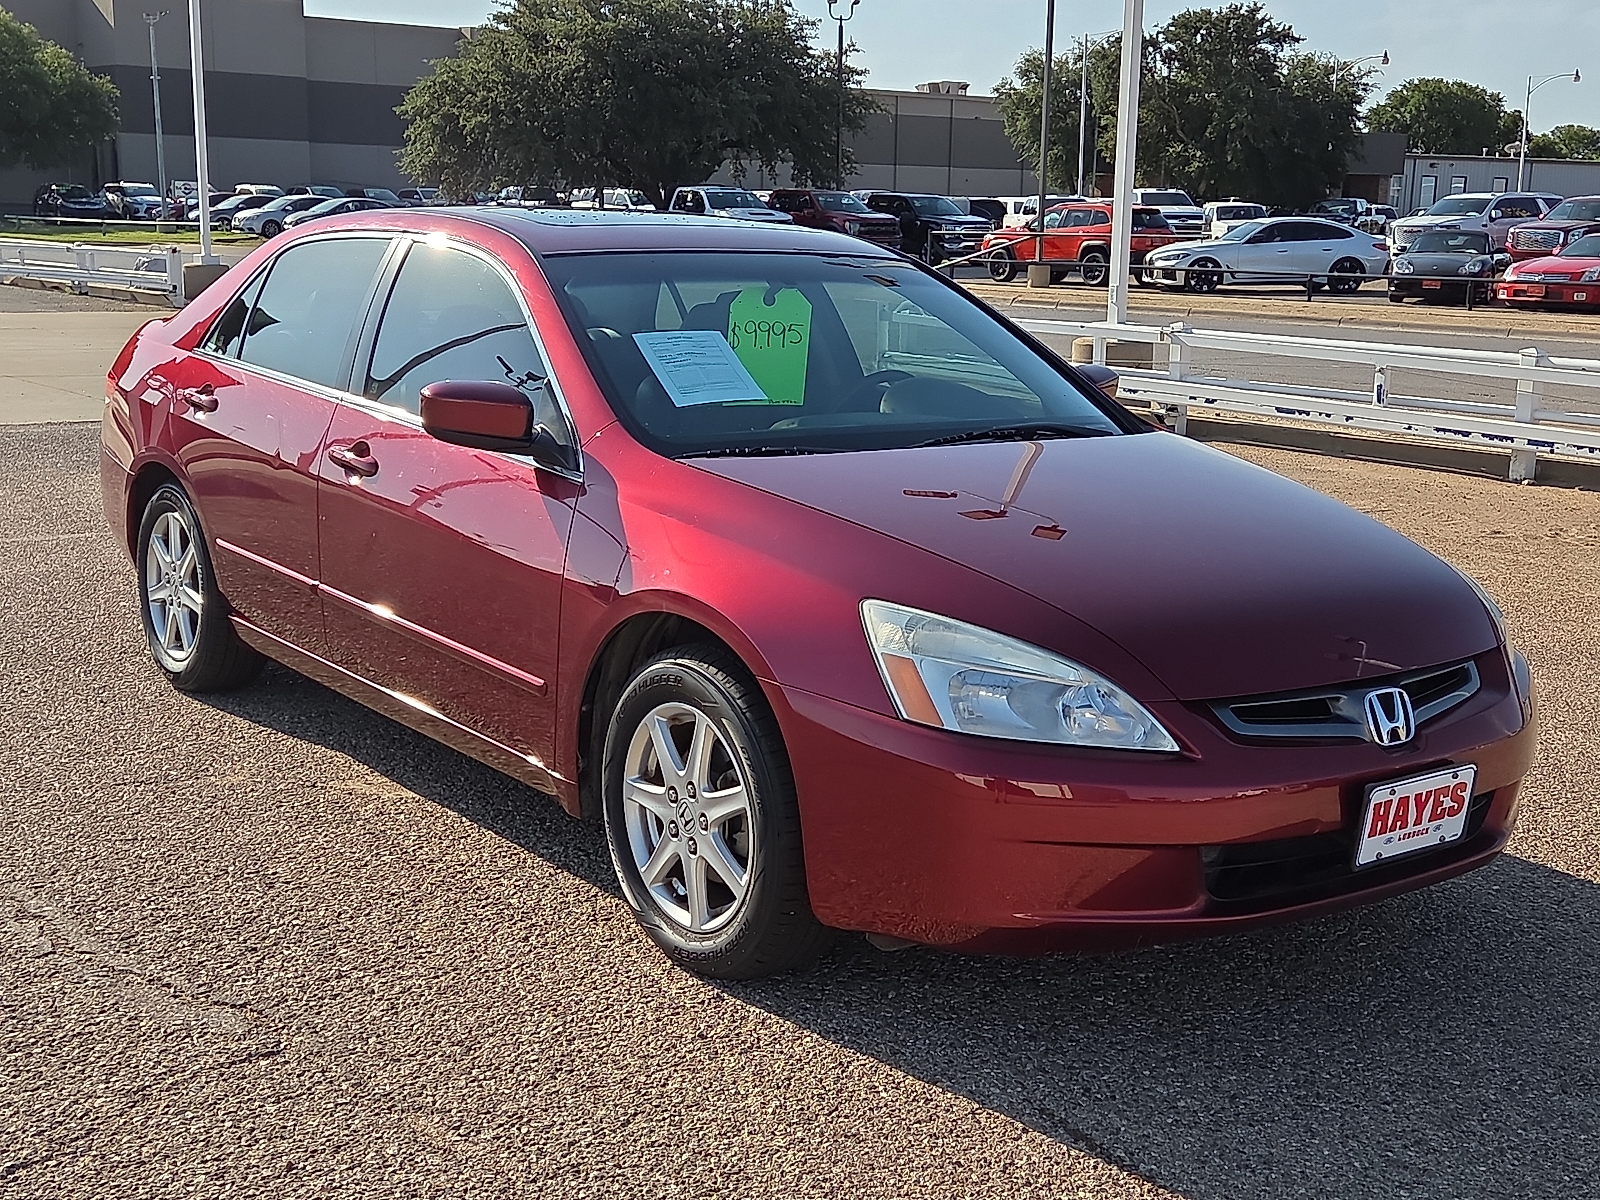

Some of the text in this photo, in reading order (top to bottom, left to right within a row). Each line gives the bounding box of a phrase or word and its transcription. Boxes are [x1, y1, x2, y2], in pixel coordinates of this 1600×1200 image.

[638, 673, 683, 693] HUGGER
[1367, 781, 1468, 839] HAYES
[672, 945, 723, 963] HUGGER
